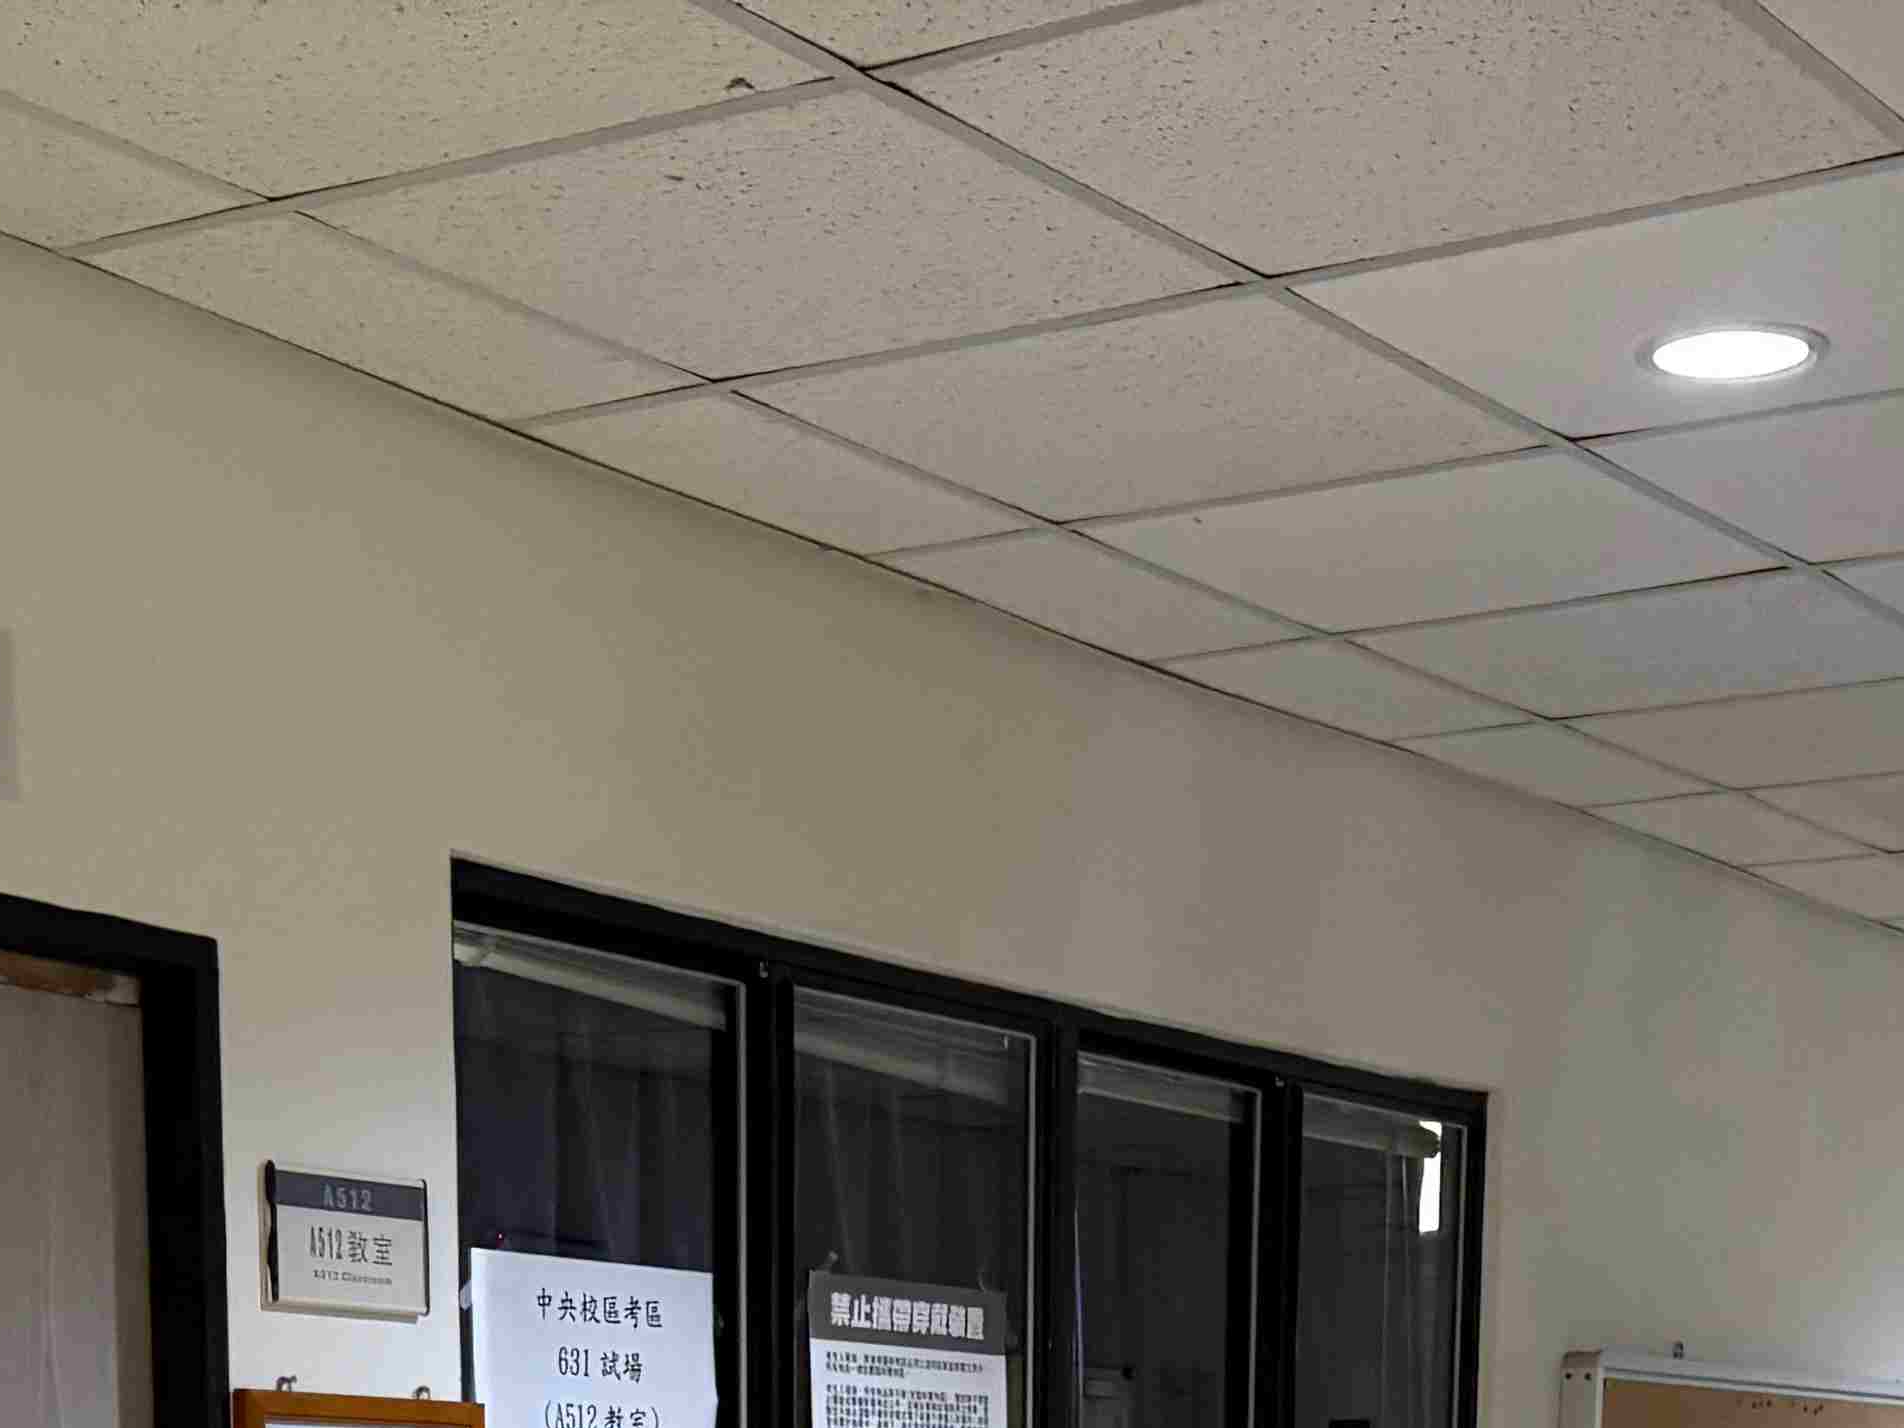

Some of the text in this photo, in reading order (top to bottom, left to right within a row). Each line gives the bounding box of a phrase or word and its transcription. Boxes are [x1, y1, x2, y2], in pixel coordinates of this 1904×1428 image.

[322, 1183, 374, 1212] A512
[309, 1225, 393, 1267] A512 教室
[536, 1287, 664, 1329] 中央校區考區
[558, 1346, 644, 1384] 631 試場
